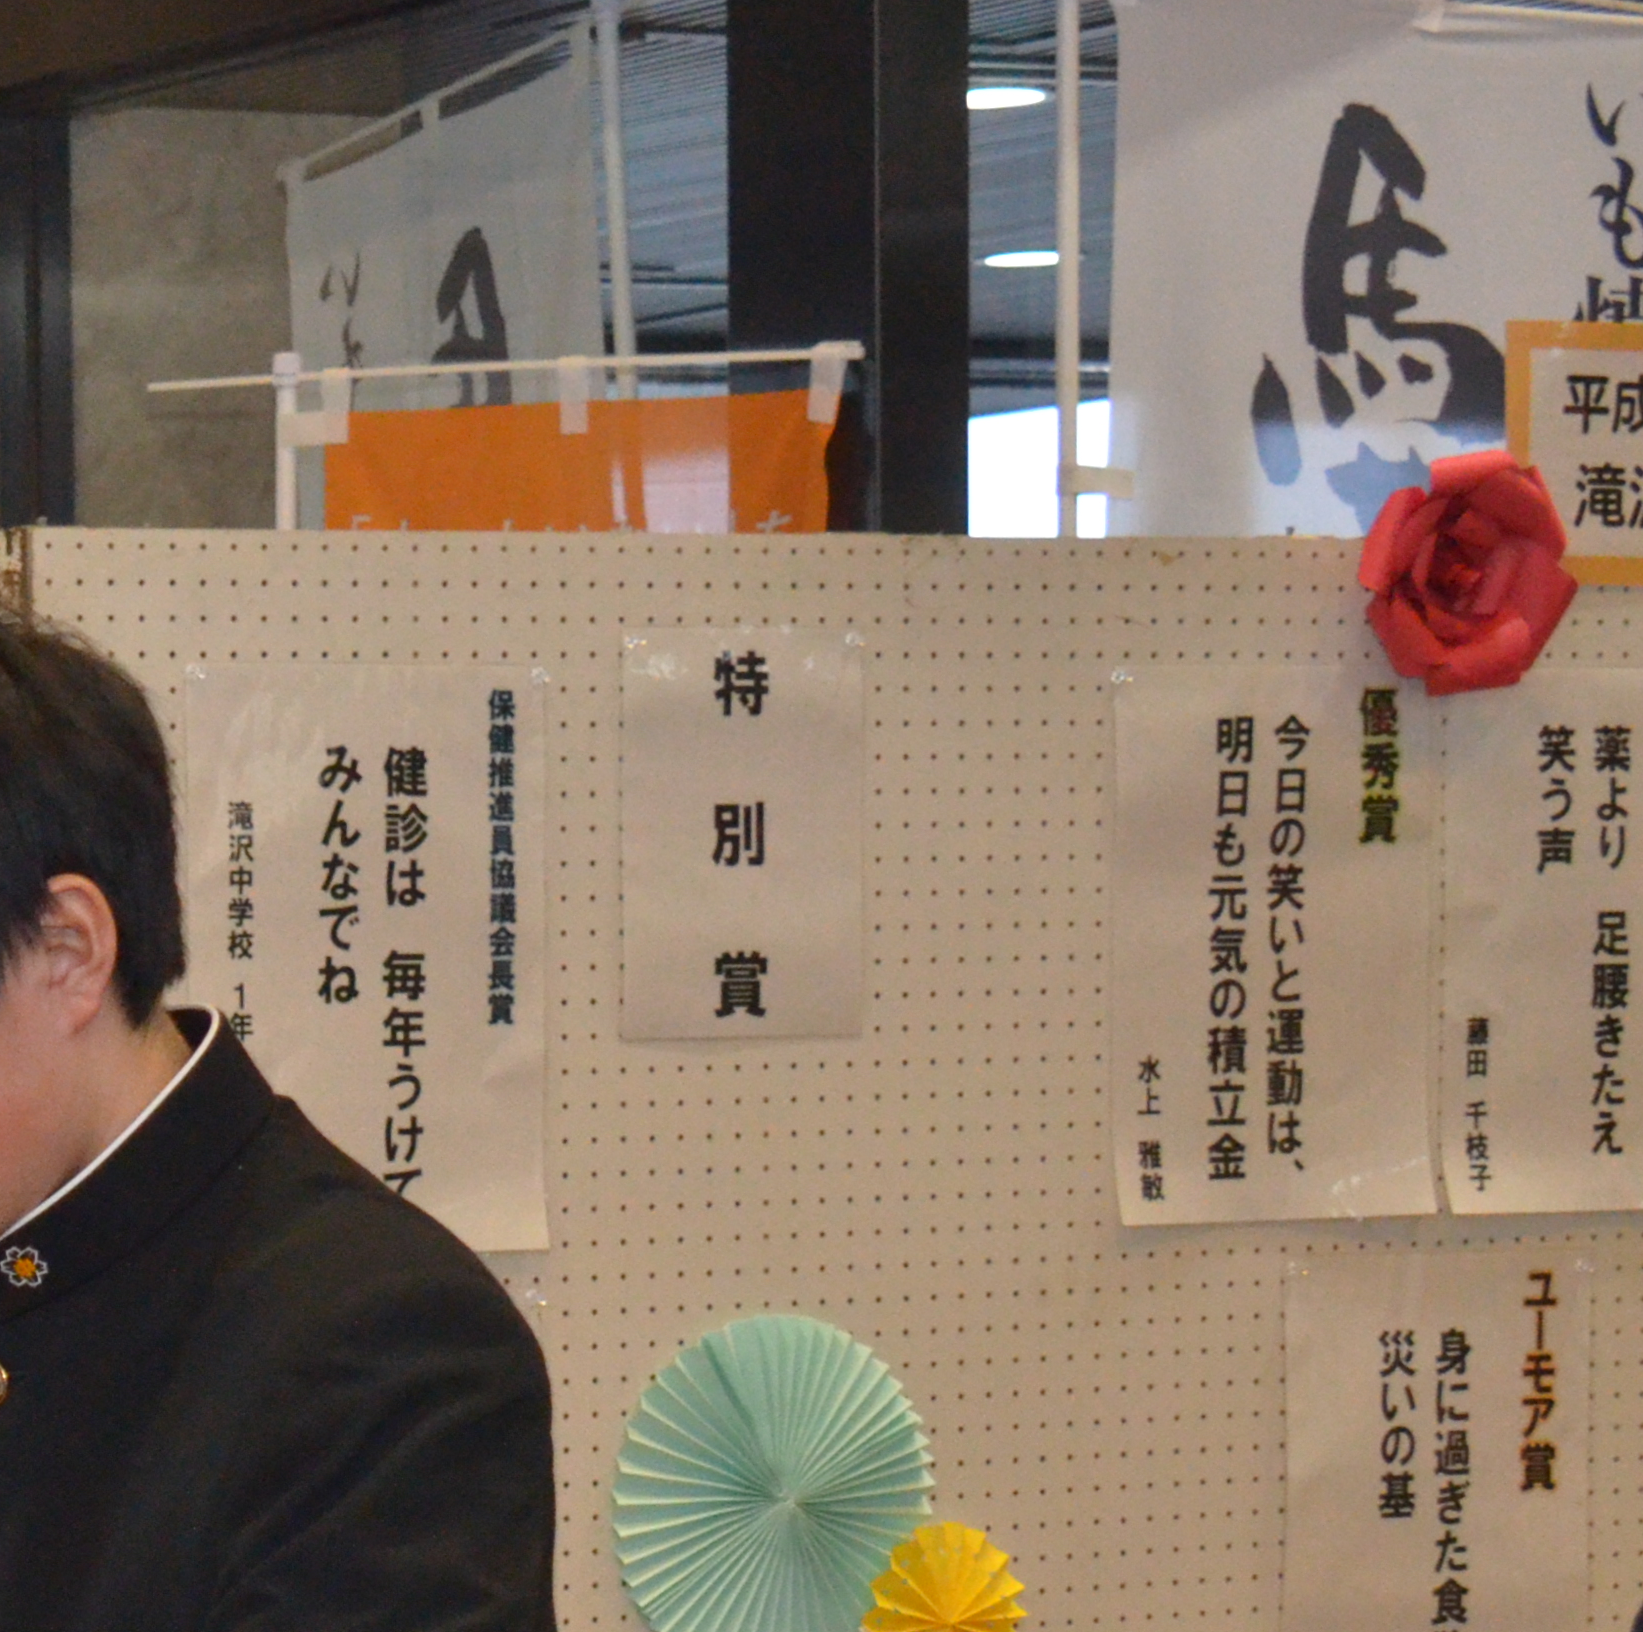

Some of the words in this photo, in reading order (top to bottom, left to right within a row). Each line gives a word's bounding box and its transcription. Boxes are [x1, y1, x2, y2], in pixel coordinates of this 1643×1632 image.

[384, 747, 427, 906] 健診は
[488, 689, 515, 1026] 保健推進員協議会長賞
[712, 651, 769, 1017] 特別賞
[1359, 687, 1398, 844] 優秀賞
[1537, 726, 1574, 872] 笑う声
[1594, 726, 1631, 869] 薬より
[227, 802, 254, 959] 滝沢中学校
[318, 745, 362, 1003] みんなでね
[1207, 716, 1254, 1180] 明日も元気の積立金
[1266, 715, 1311, 1172] 今日の笑いと運動は、
[1138, 1055, 1161, 1116] 水上
[1591, 912, 1629, 1155] 足腰きたえ
[1378, 1331, 1416, 1518] 災いの基
[1521, 1271, 1557, 1492] ユーモア賞
